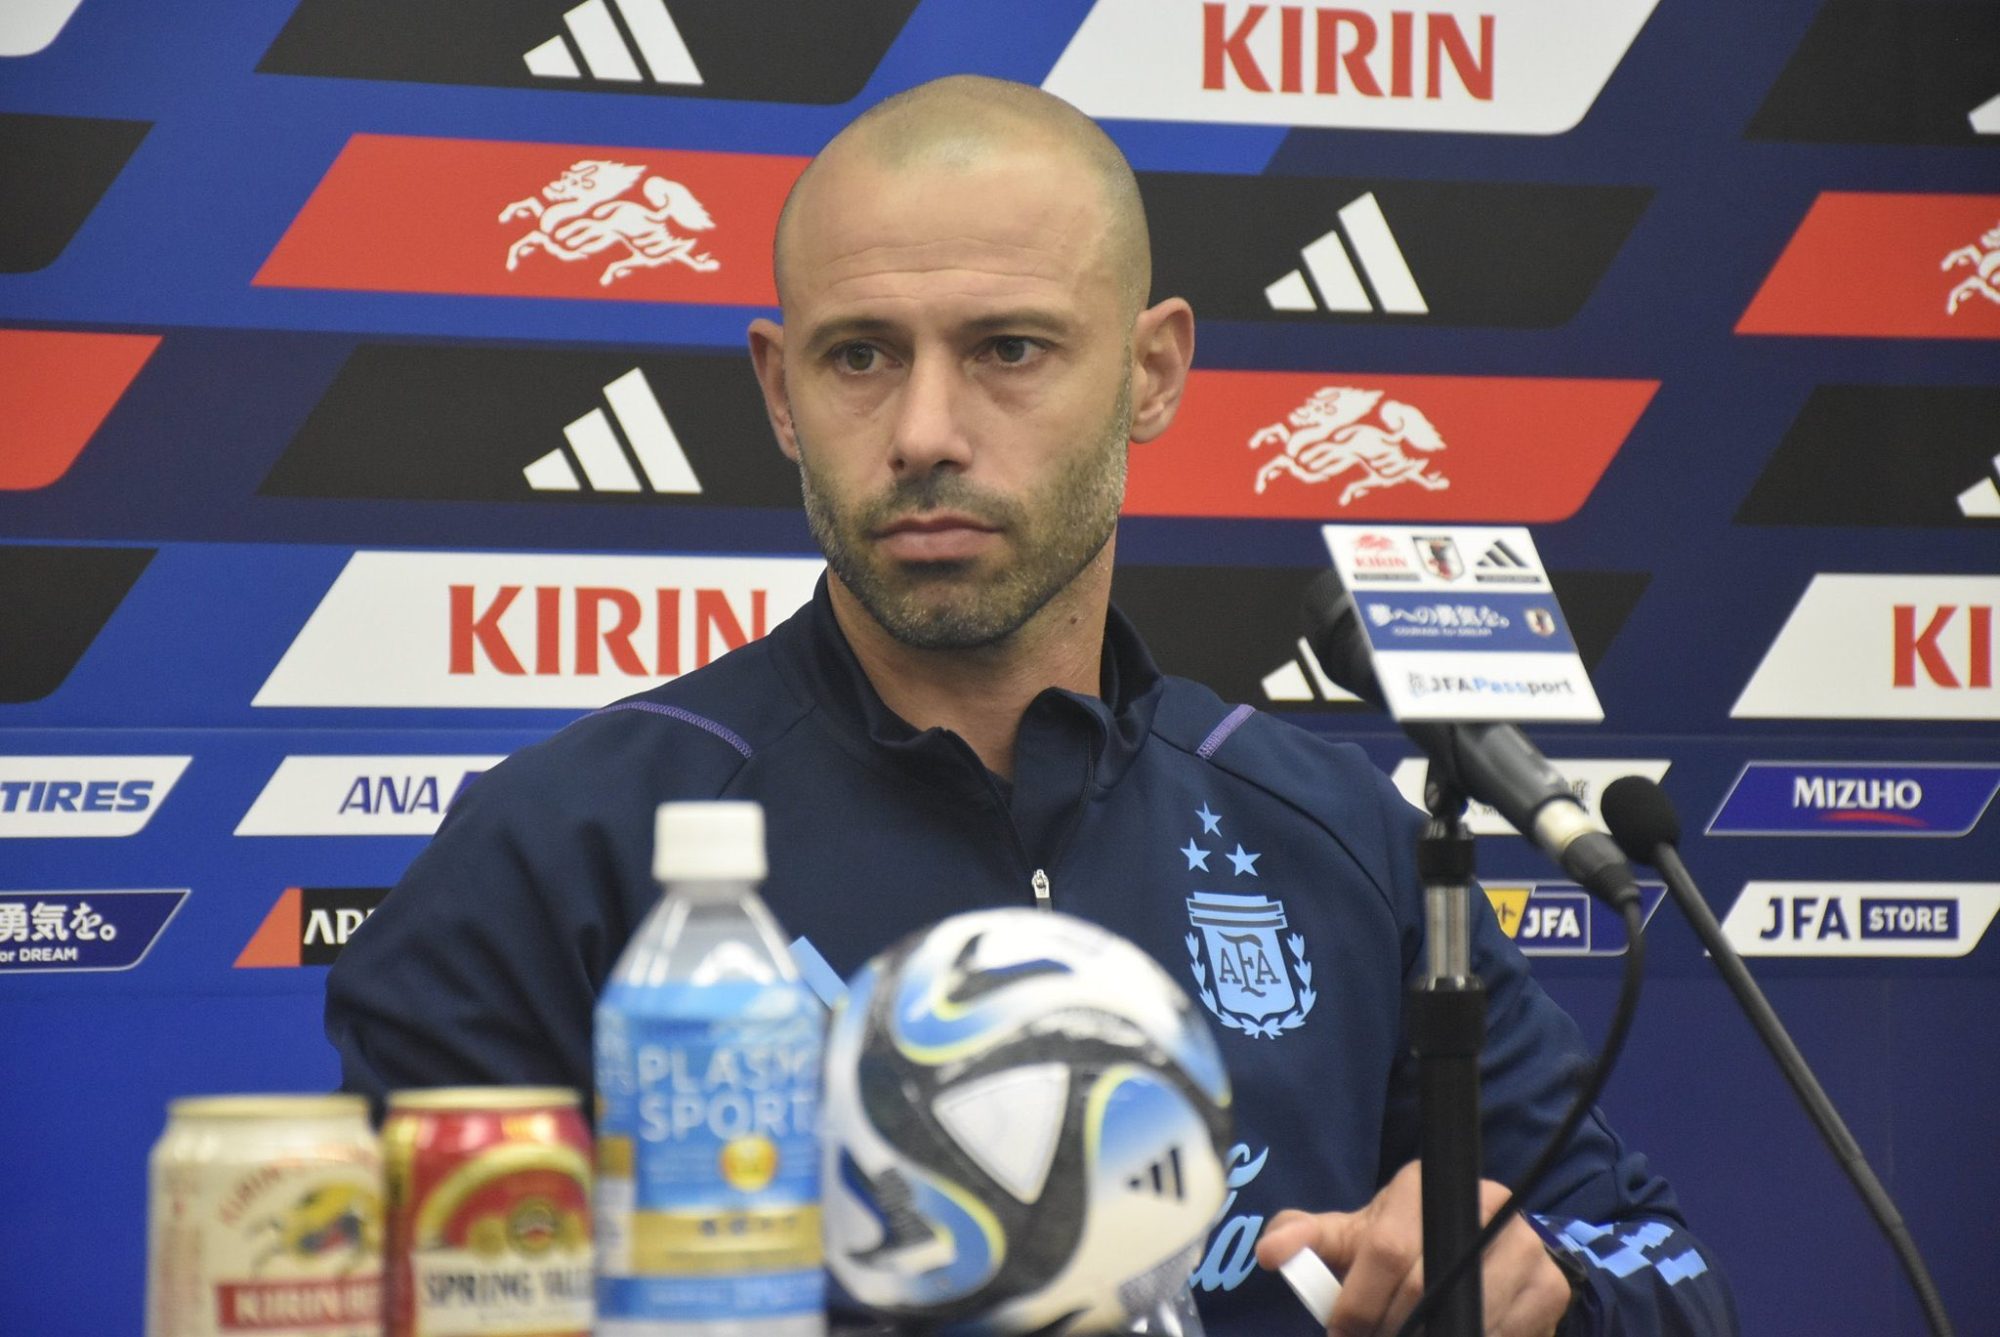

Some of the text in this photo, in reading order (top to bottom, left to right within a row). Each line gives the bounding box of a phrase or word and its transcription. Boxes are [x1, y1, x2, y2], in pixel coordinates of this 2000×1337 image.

[1202, 3, 1495, 101] KIRIN
[448, 584, 767, 678] KIRIN
[1892, 604, 1992, 689] KI
[0, 780, 155, 812] TIRES
[338, 776, 440, 815] ANA
[1793, 776, 1923, 810] MIZUHO
[1522, 908, 1581, 938] JFA
[1759, 897, 1850, 940] JFA
[1869, 906, 1949, 932] STORE
[19, 948, 78, 962] DREAM
[1217, 931, 1281, 998] AFA
